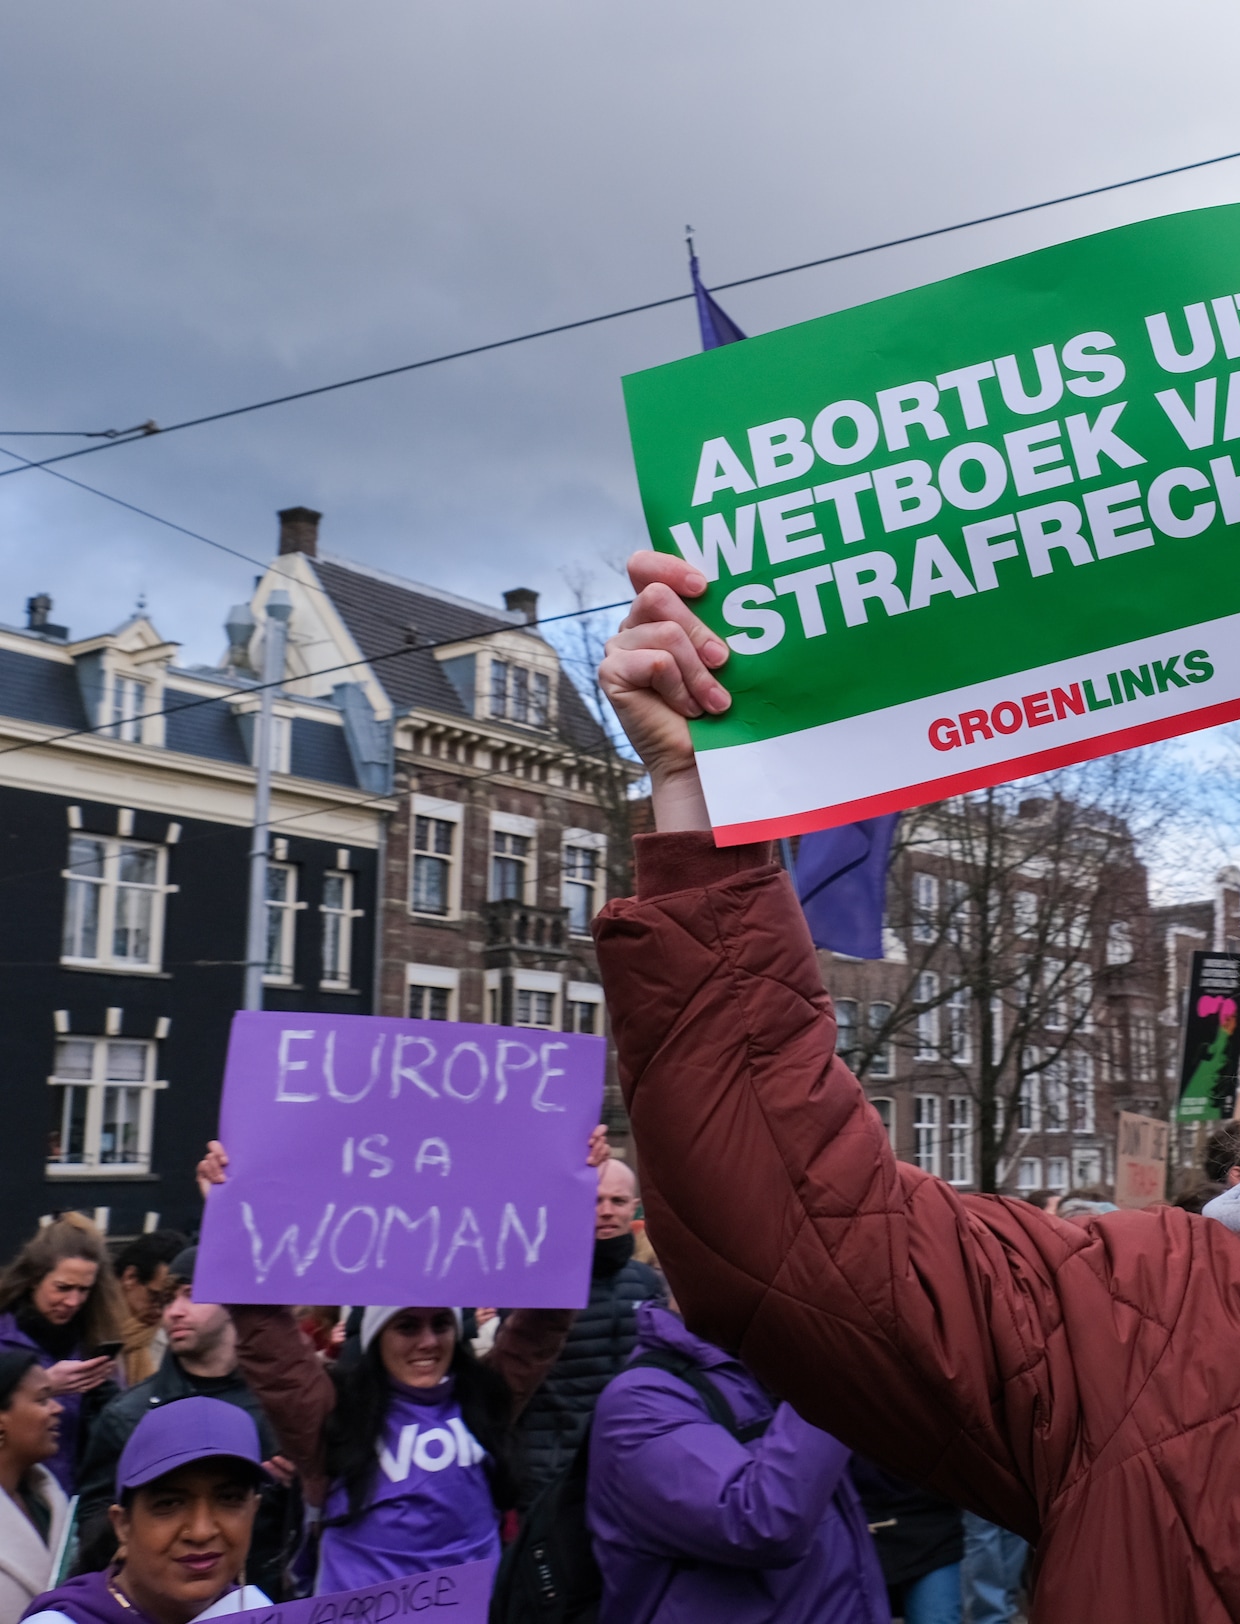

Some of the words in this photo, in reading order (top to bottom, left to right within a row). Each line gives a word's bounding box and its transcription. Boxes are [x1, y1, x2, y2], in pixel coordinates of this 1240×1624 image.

[692, 332, 1125, 506] ABORTUS
[670, 402, 1146, 583] WETBOEK
[928, 650, 1214, 752] GROENLINKS
[275, 1029, 568, 1113] EUROPE
[342, 1133, 393, 1179] IS
[415, 1136, 451, 1177] A
[241, 1201, 547, 1284] WOMAN
